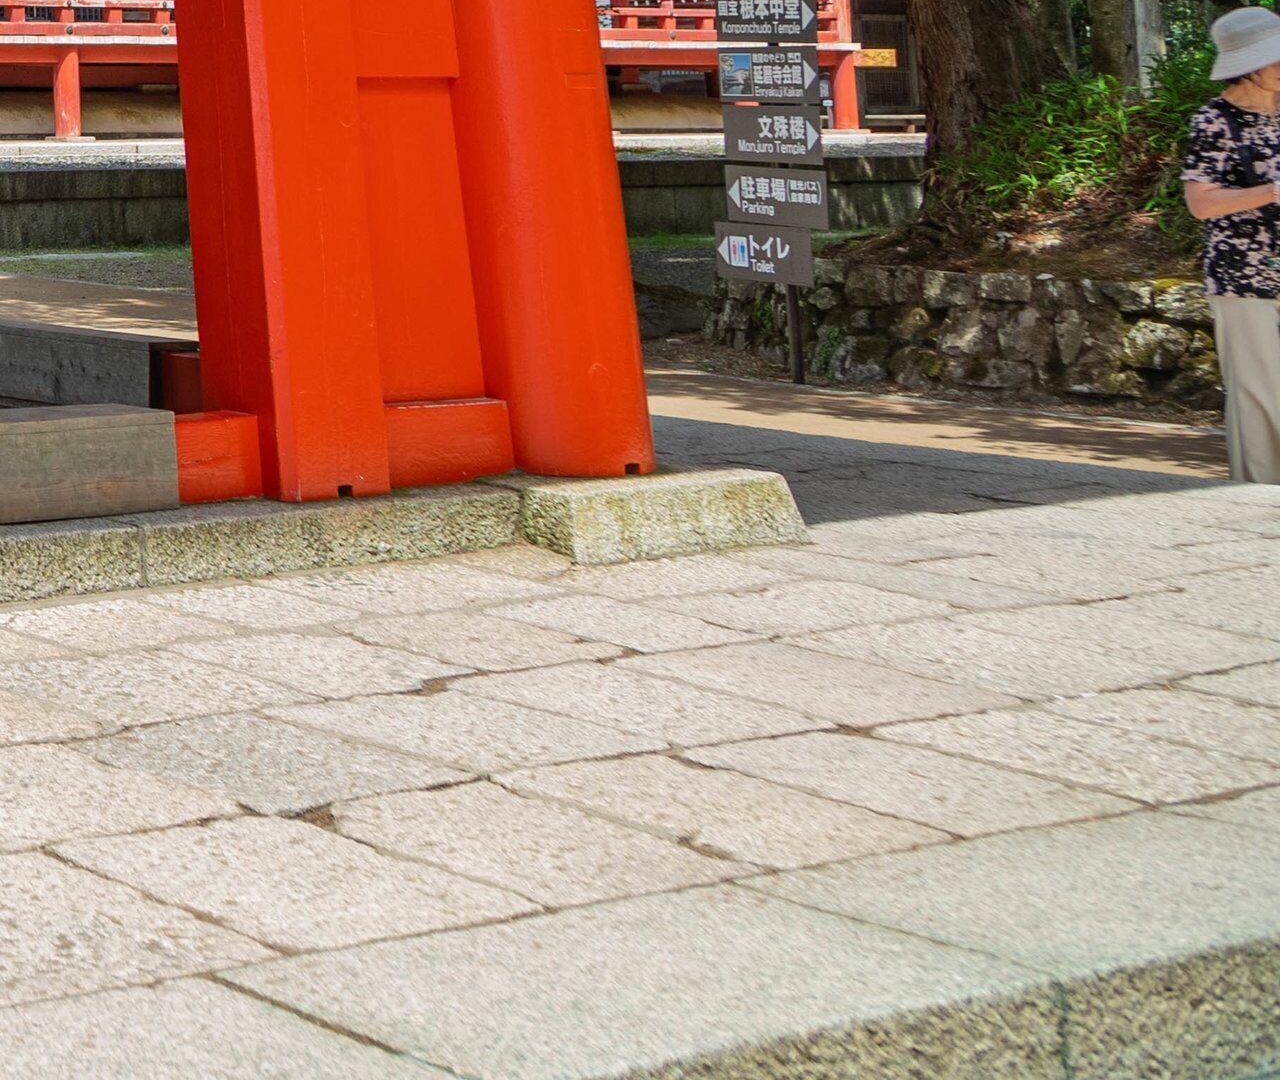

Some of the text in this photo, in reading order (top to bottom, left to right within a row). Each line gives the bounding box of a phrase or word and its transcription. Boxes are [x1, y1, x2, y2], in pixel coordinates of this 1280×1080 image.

[721, 21, 801, 35] Konponchudo Temple
[758, 115, 806, 140] 文殊楼
[738, 139, 806, 155] Monjuro Temple
[740, 176, 786, 202] 駐車場
[742, 200, 774, 216] Parking
[748, 234, 790, 259] トイレ
[750, 258, 775, 274] Toilet
